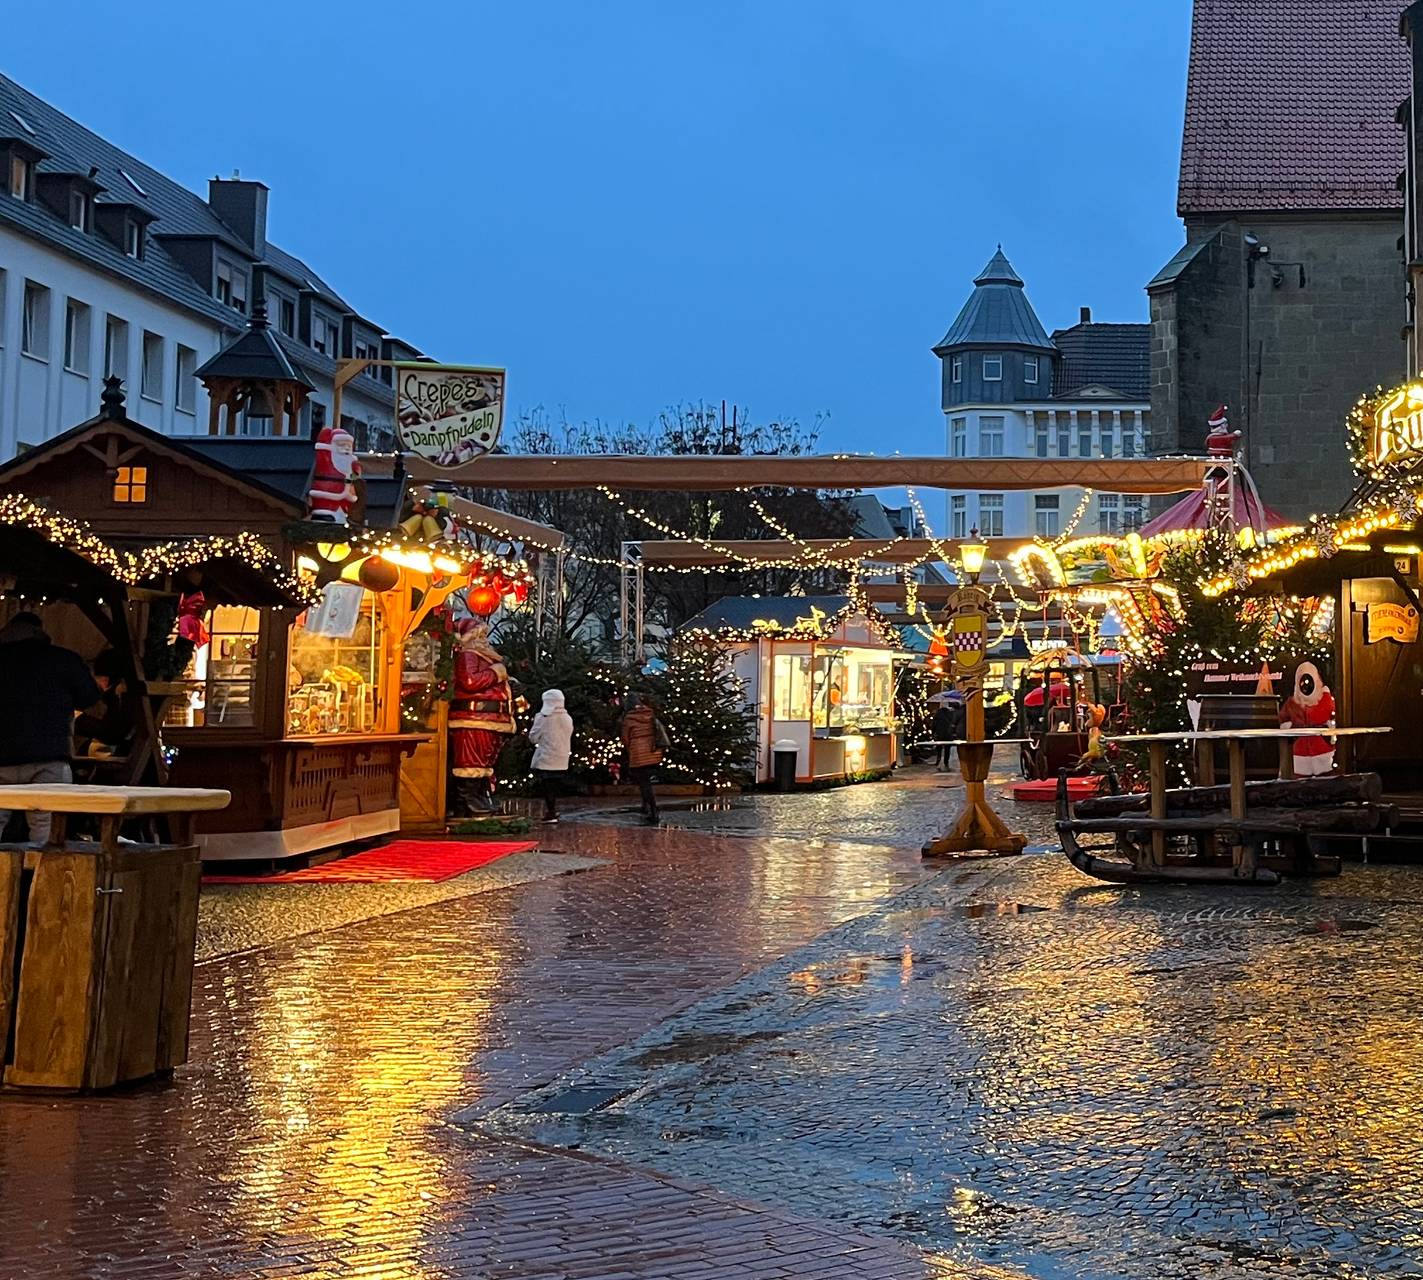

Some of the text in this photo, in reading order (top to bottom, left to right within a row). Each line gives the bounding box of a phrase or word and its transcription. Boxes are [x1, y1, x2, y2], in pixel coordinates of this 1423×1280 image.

[404, 373, 477, 414] Crepes
[410, 410, 495, 451] Dampfnudeln
[1396, 561, 1406, 570] 24
